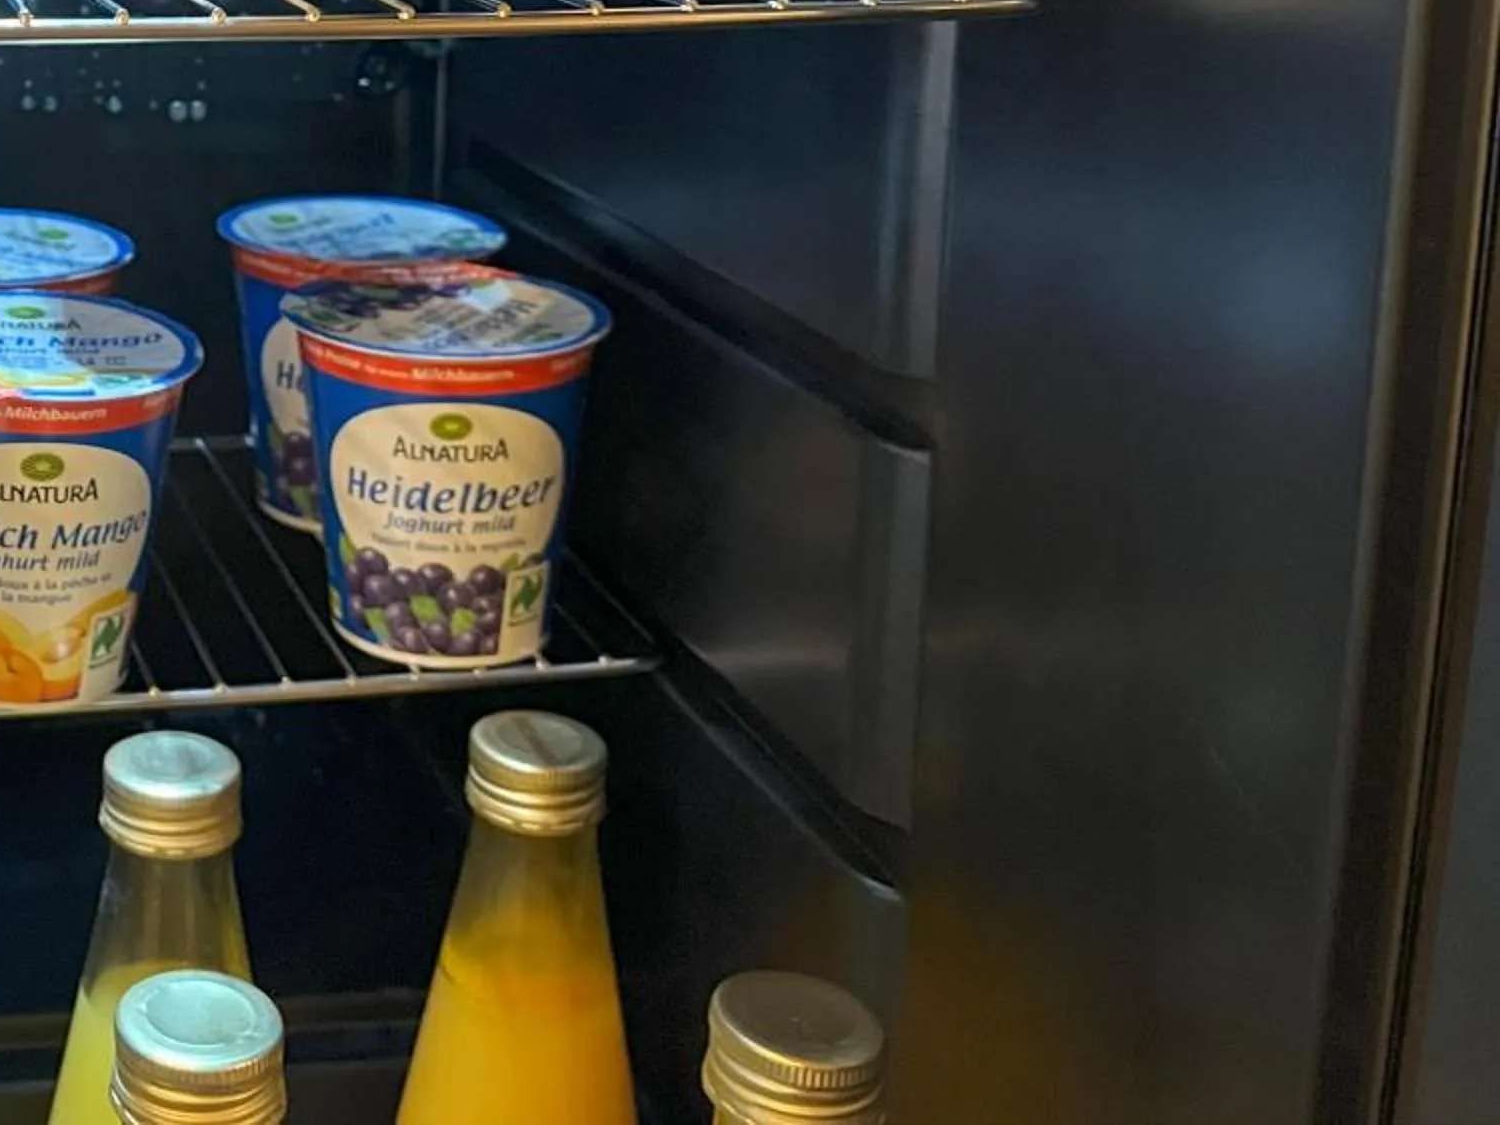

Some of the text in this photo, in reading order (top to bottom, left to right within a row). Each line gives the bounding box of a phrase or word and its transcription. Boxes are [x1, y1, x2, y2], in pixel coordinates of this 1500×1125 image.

[50, 331, 164, 348] Mango
[3, 404, 108, 422] Milchbauern
[392, 435, 510, 463] ALNATURA
[346, 466, 556, 515] Heidelbeer
[50, 509, 148, 551] Mango
[384, 511, 516, 535] Joghurt mild
[56, 549, 101, 572] mild
